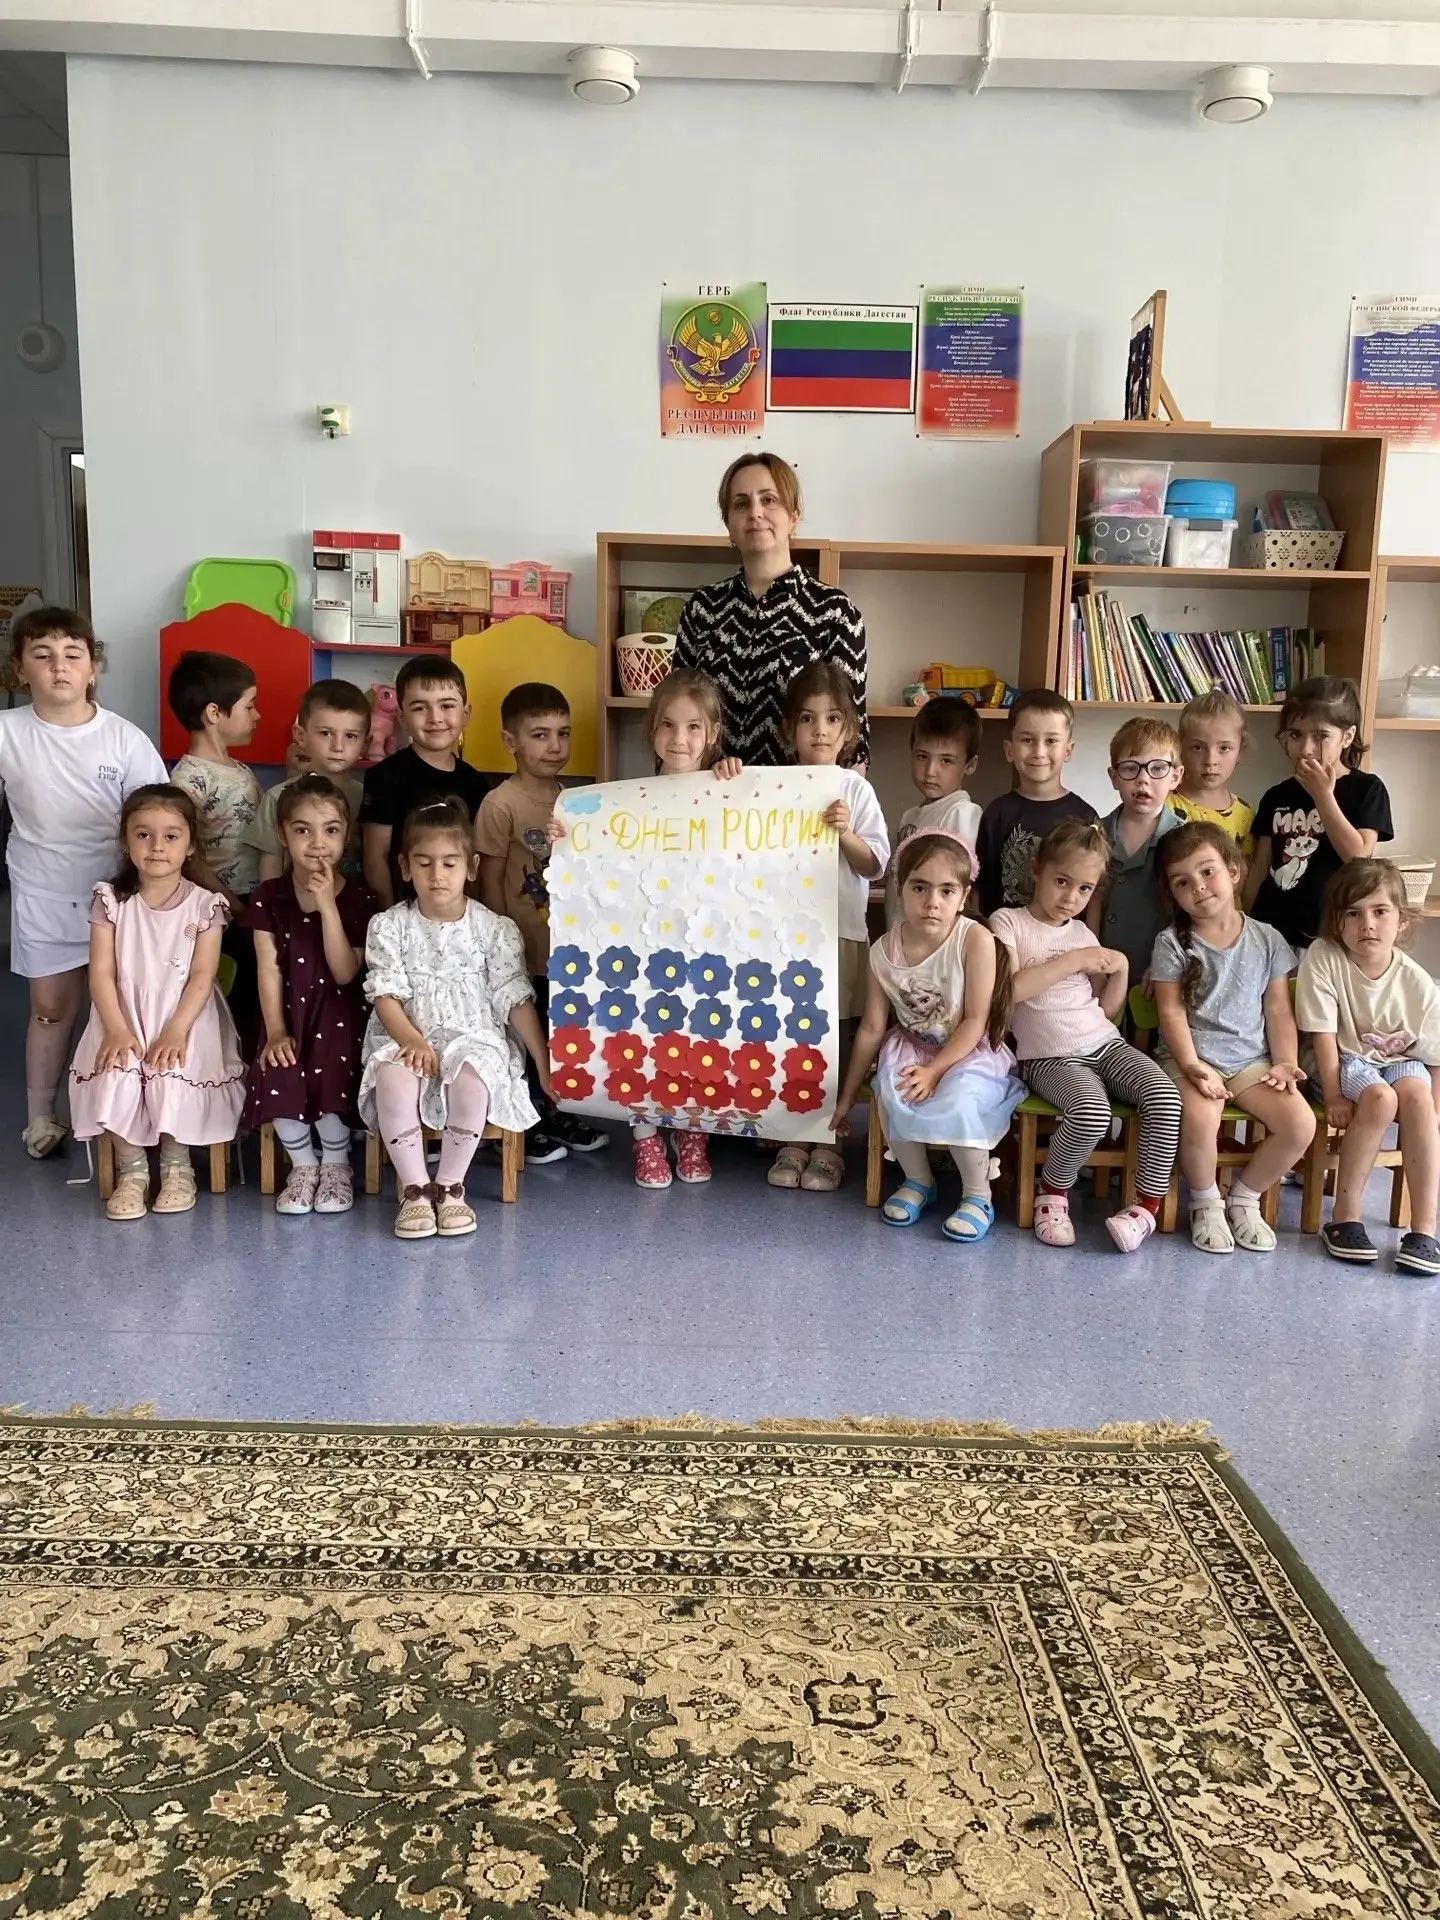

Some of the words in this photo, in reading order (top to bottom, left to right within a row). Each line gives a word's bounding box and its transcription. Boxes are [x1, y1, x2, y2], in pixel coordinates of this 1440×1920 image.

[699, 285, 731, 296] ГЕРБ
[779, 308, 802, 316] Флаг
[806, 308, 861, 318] Республики
[863, 309, 907, 319] Дагестан
[668, 409, 757, 421] РЕСПУБЛИКИ
[677, 423, 746, 435] ДАГЕСТАН
[1272, 808, 1326, 834] MAR
[571, 821, 591, 852] С
[609, 808, 706, 853] ДНЕМ
